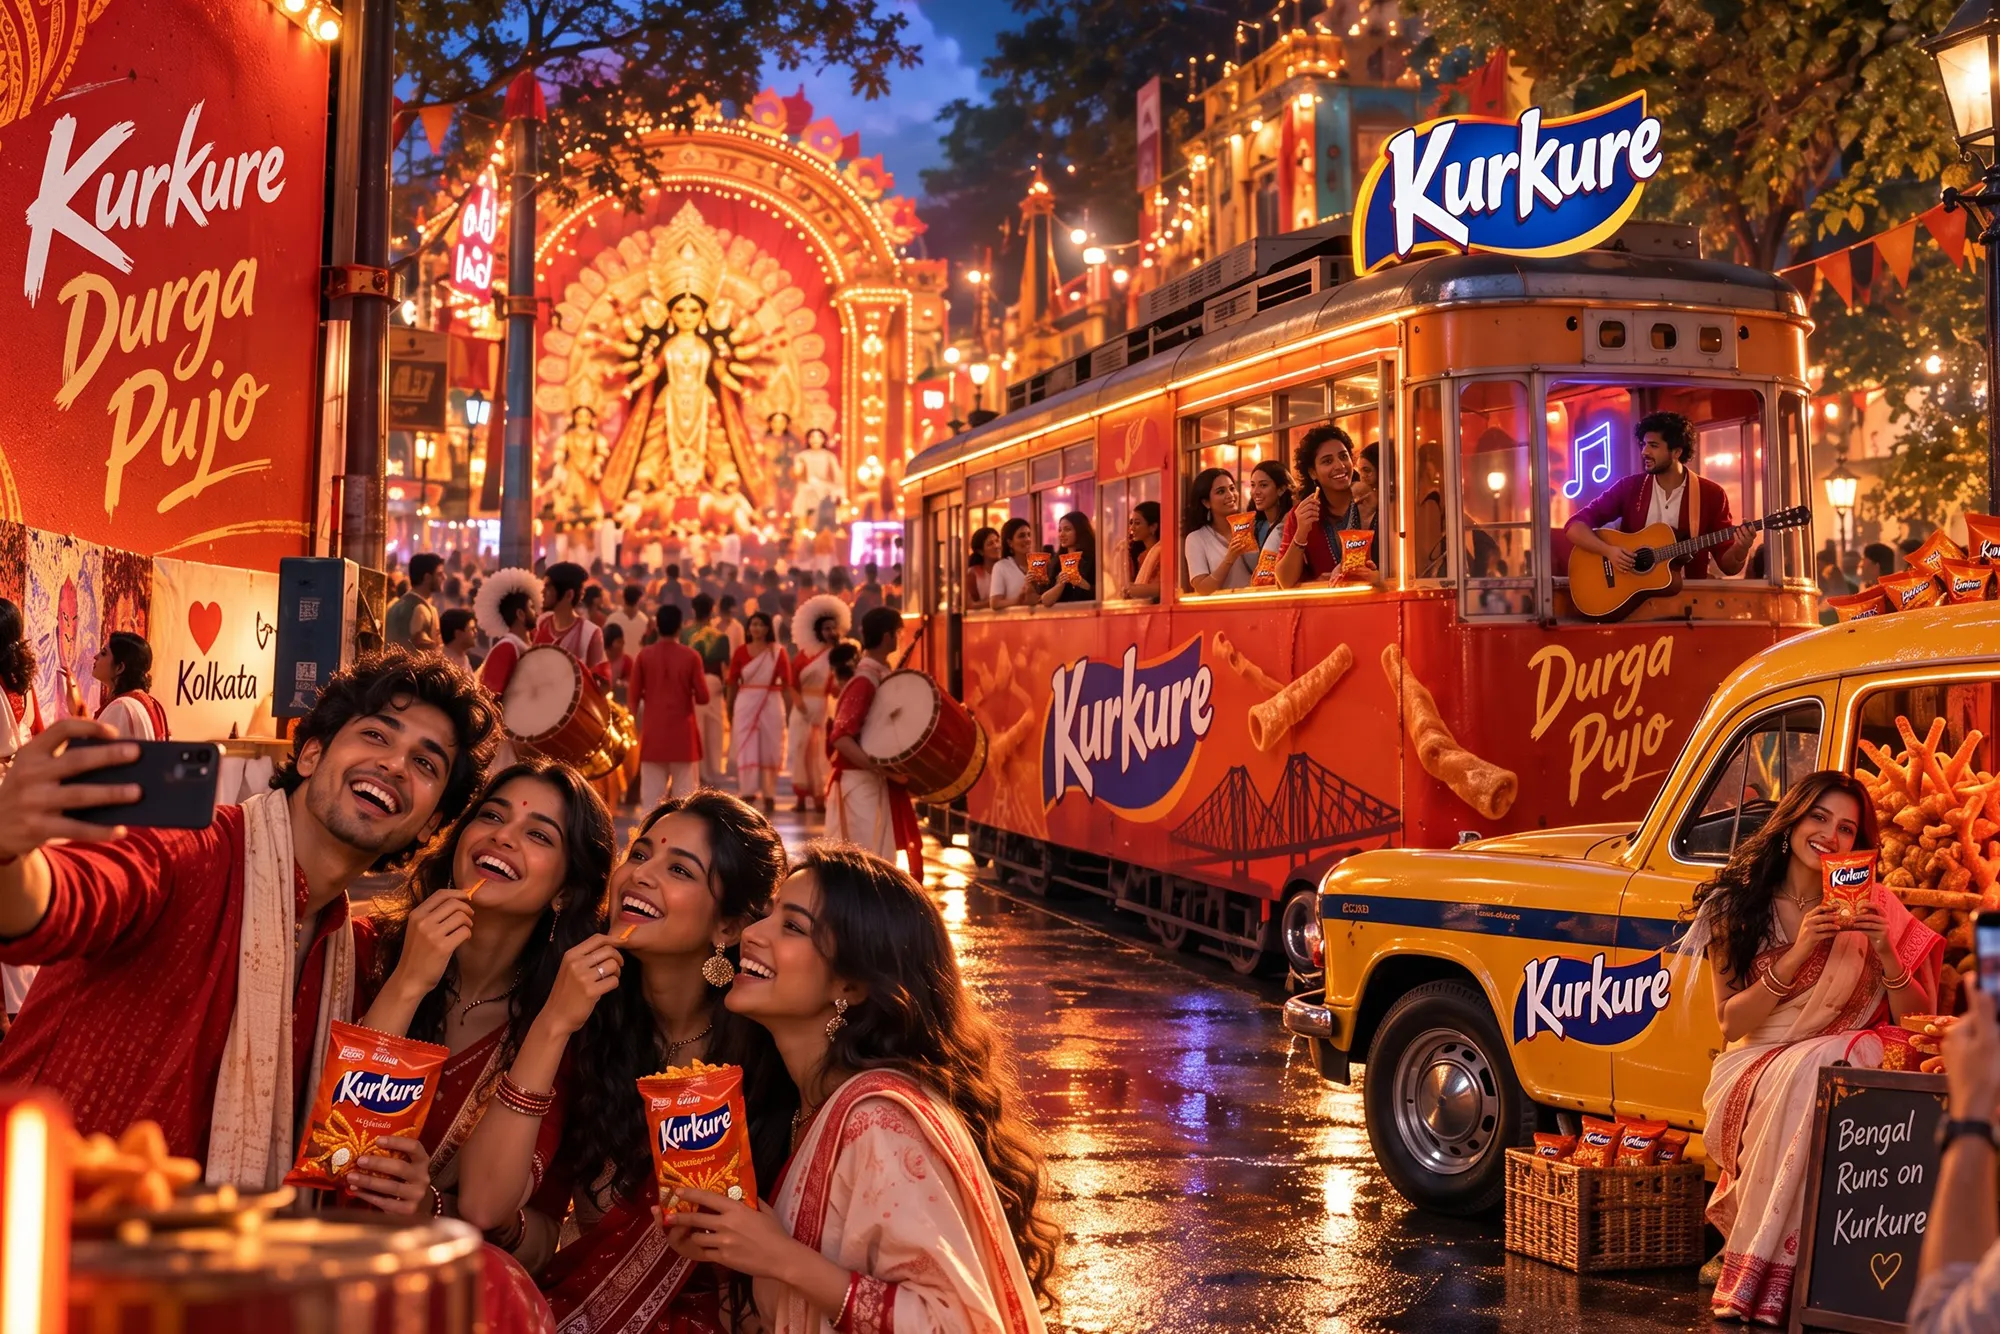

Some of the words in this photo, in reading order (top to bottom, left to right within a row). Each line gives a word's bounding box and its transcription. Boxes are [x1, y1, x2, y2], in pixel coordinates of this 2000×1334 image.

[24, 99, 286, 308] Kurkure
[1388, 107, 1663, 258] Kurkure
[53, 257, 258, 412] Durga
[104, 361, 272, 524] Pujo
[176, 660, 257, 707] Kolkata
[1052, 644, 1214, 801] Kurkure
[1528, 635, 1673, 741] Durga
[1568, 706, 1673, 807] Pujo
[1525, 954, 1671, 1039] Kurkure
[338, 1071, 425, 1107] Kurkure
[660, 1111, 733, 1154] Kurkure
[1838, 1109, 1915, 1156] Bengal
[1836, 1161, 1889, 1195] Runs
[1897, 1163, 1923, 1185] on
[1833, 1204, 1928, 1246] Kurkure
